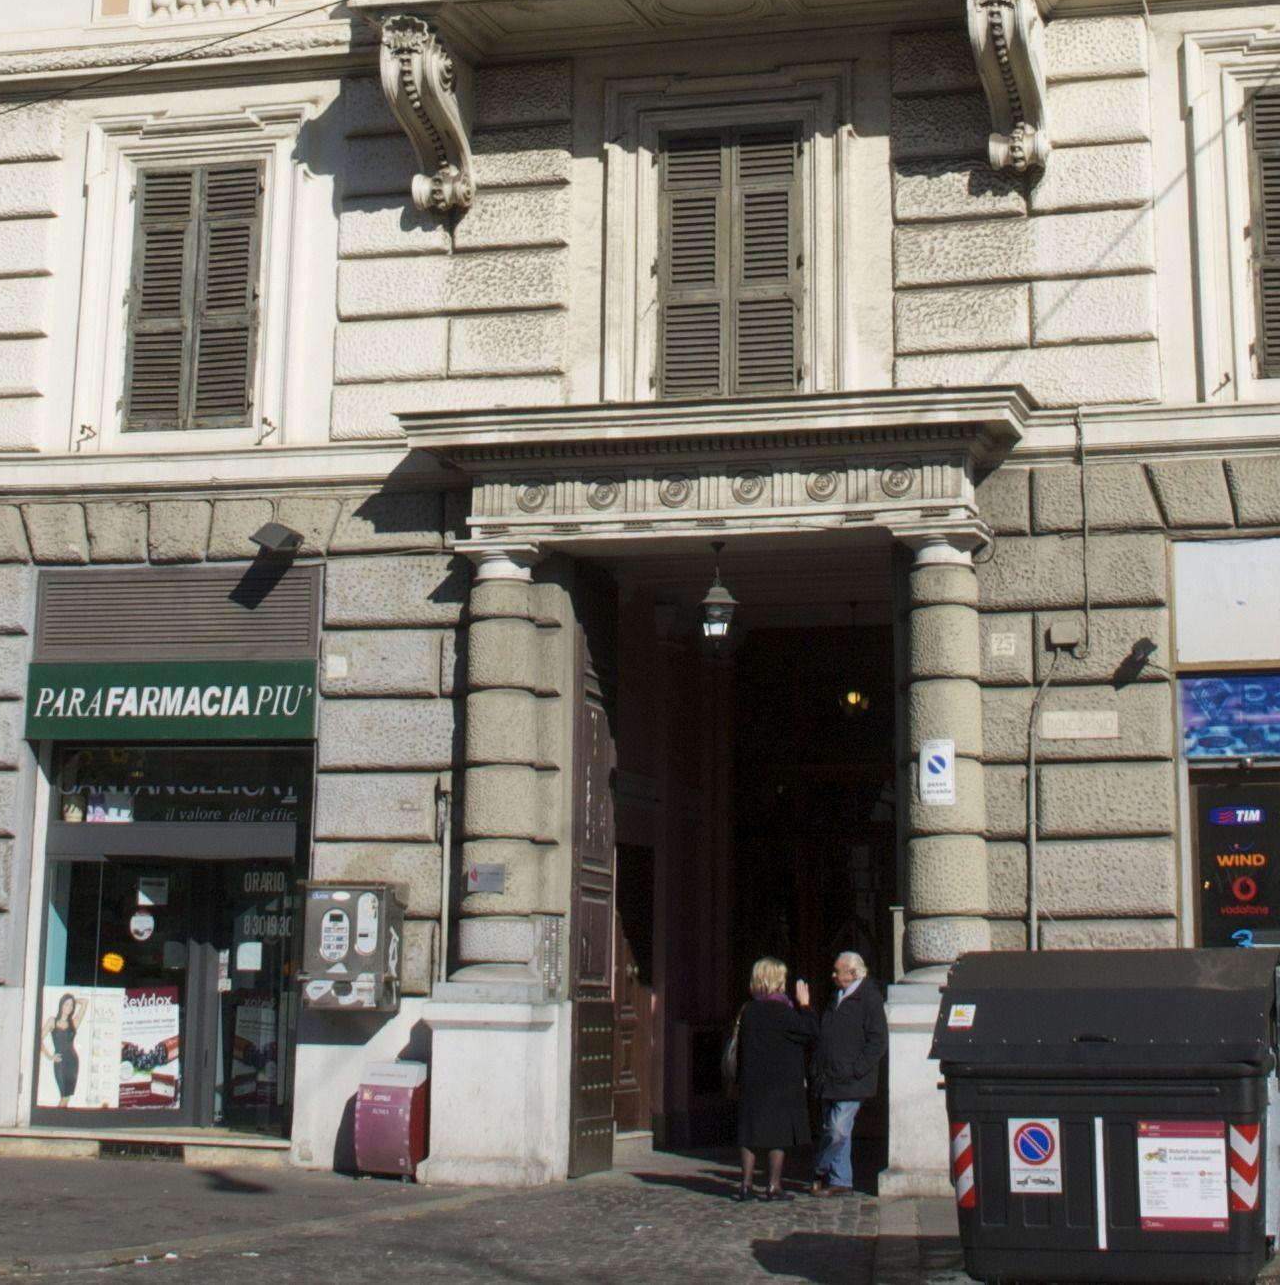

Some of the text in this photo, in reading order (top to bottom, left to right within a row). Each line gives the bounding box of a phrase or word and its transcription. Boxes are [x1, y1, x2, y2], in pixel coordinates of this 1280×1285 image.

[995, 636, 1012, 651] 25
[179, 805, 221, 820] valore
[1235, 809, 1261, 822] TIM
[1216, 853, 1266, 867] WIND
[244, 871, 285, 892] ORARIO
[1220, 905, 1269, 915] vodafone
[123, 992, 172, 1009] Revidox
